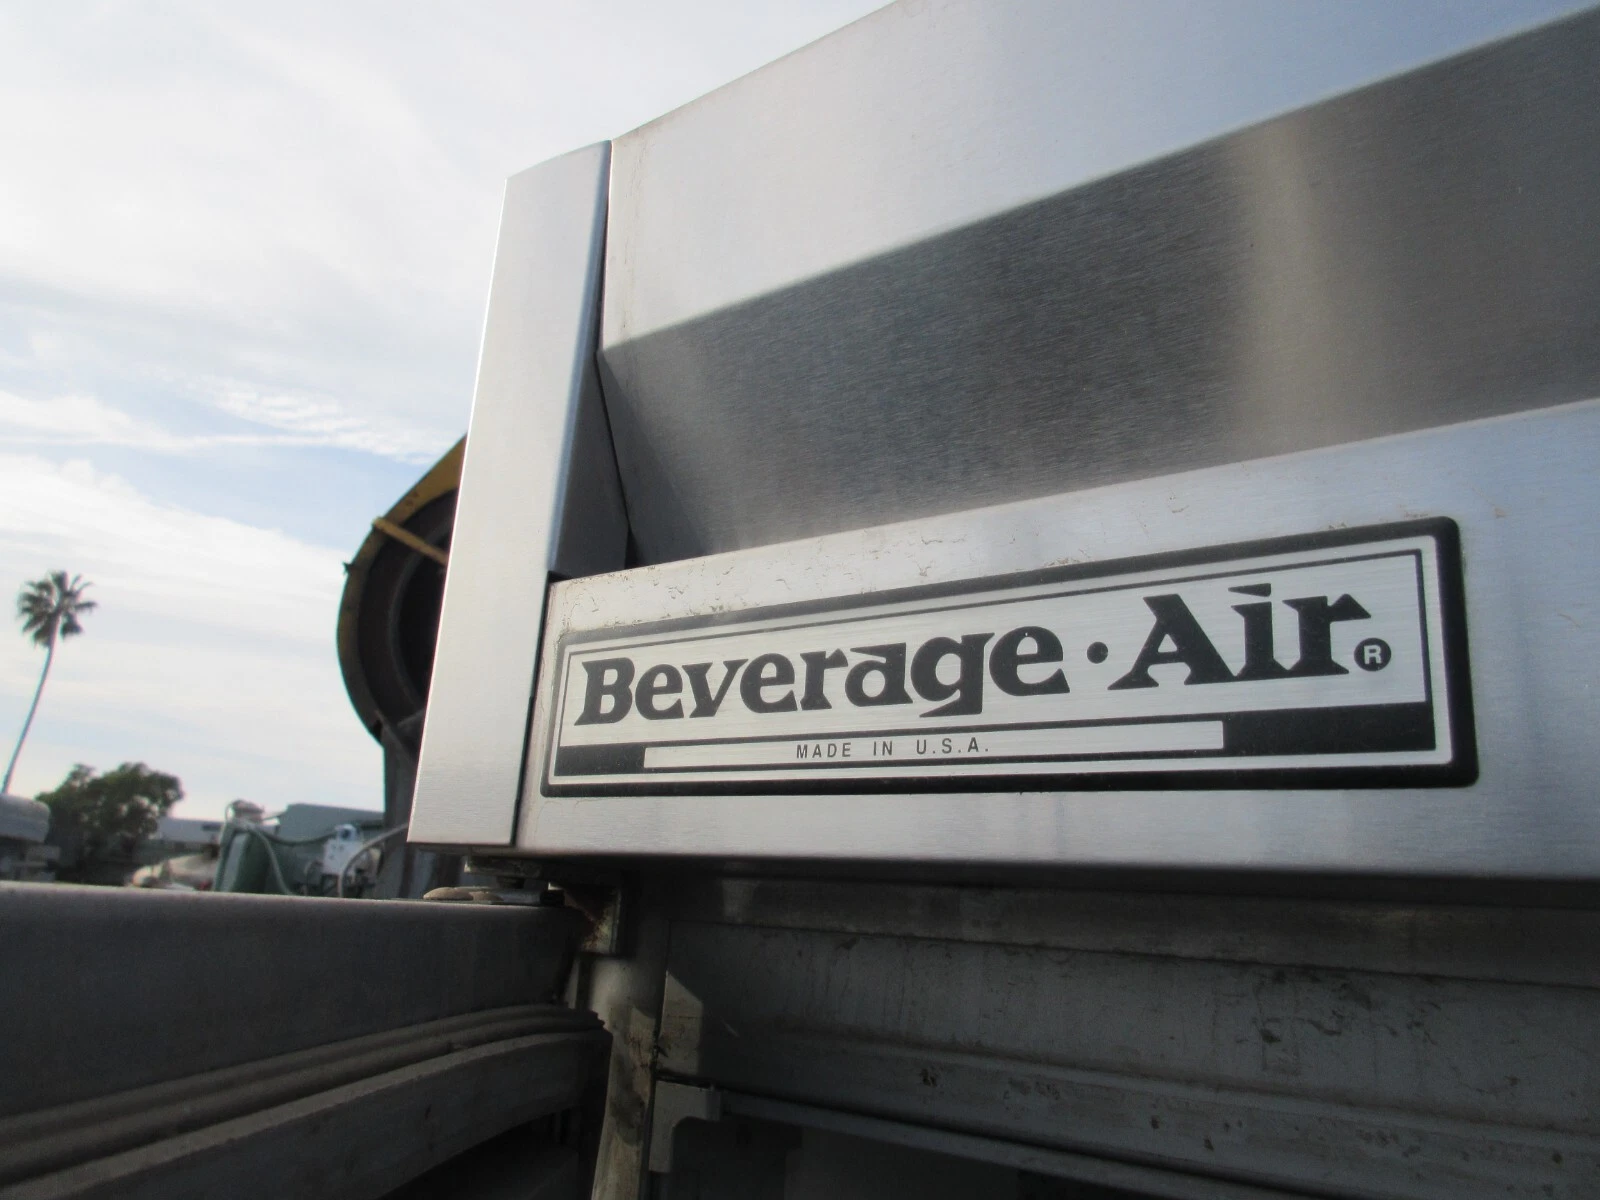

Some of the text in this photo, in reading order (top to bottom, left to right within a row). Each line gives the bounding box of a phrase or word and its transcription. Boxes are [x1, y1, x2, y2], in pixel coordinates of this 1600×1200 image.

[796, 737, 990, 759] MADE IN U.S.A.
